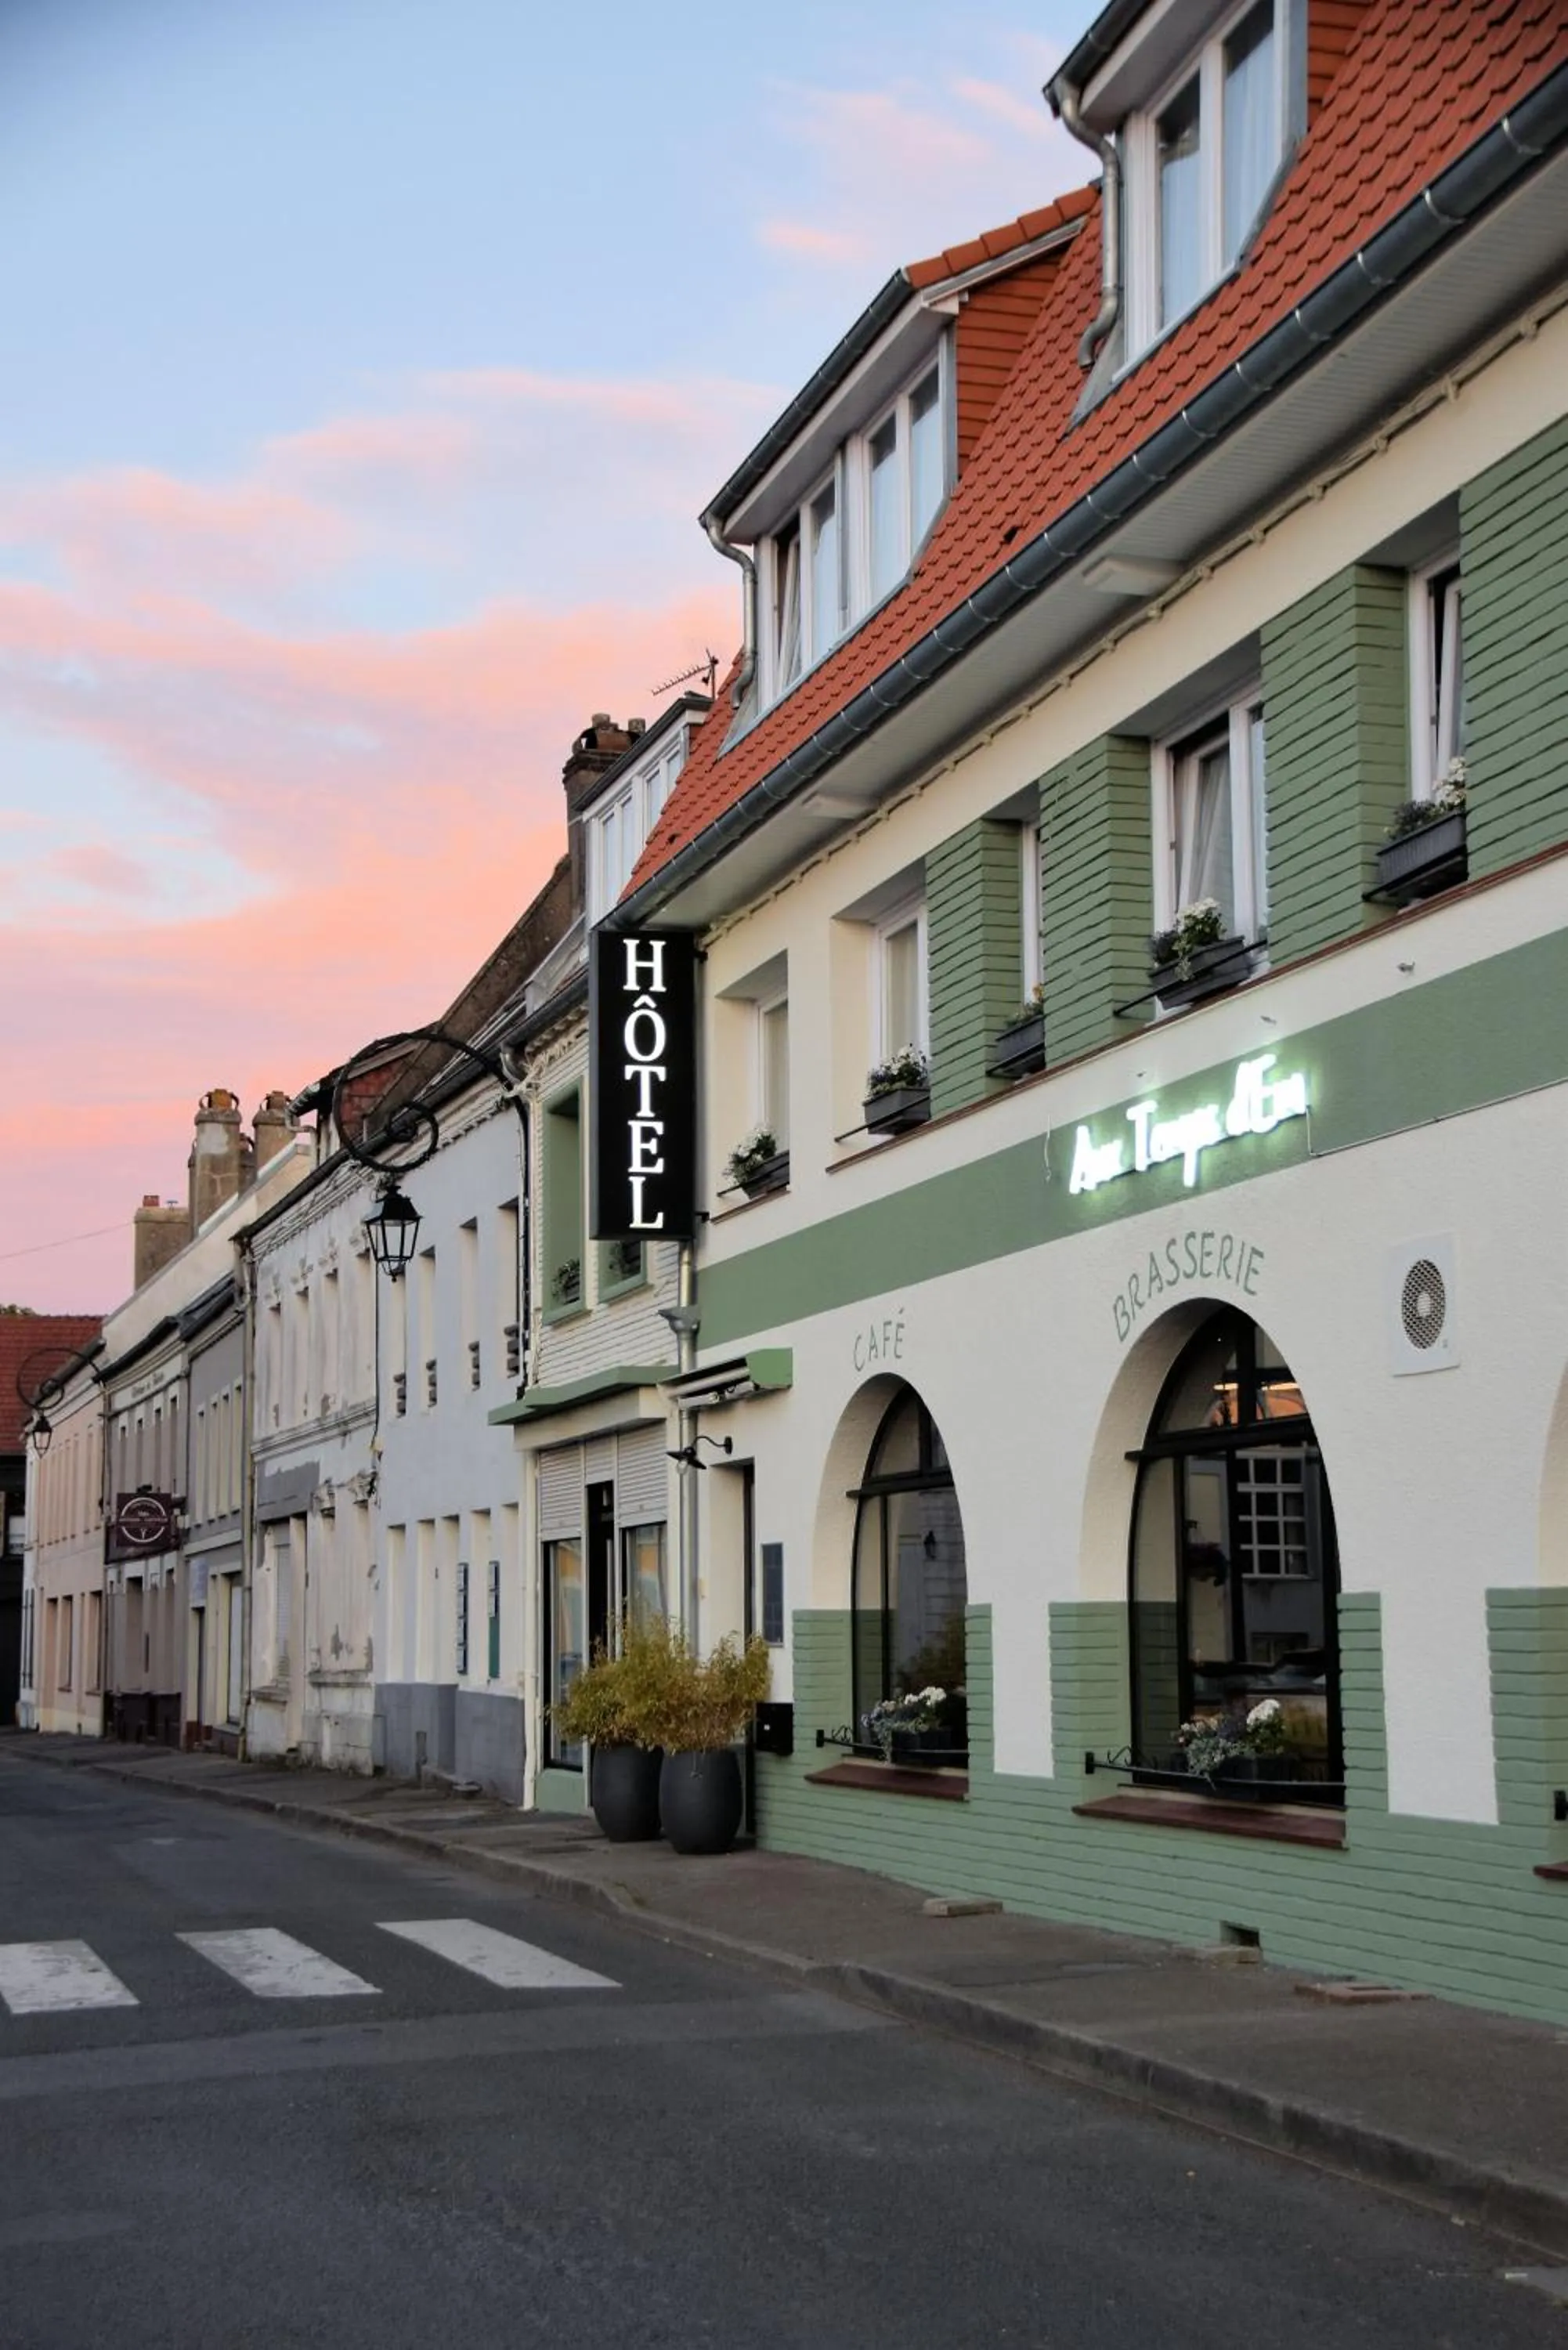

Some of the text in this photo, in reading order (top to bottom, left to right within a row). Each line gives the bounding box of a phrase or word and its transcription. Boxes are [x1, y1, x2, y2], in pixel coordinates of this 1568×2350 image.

[623, 938, 667, 1229] HÔTEL
[853, 1307, 905, 1372] CAFÉ
[1113, 1231, 1264, 1342] BRASSERIE
